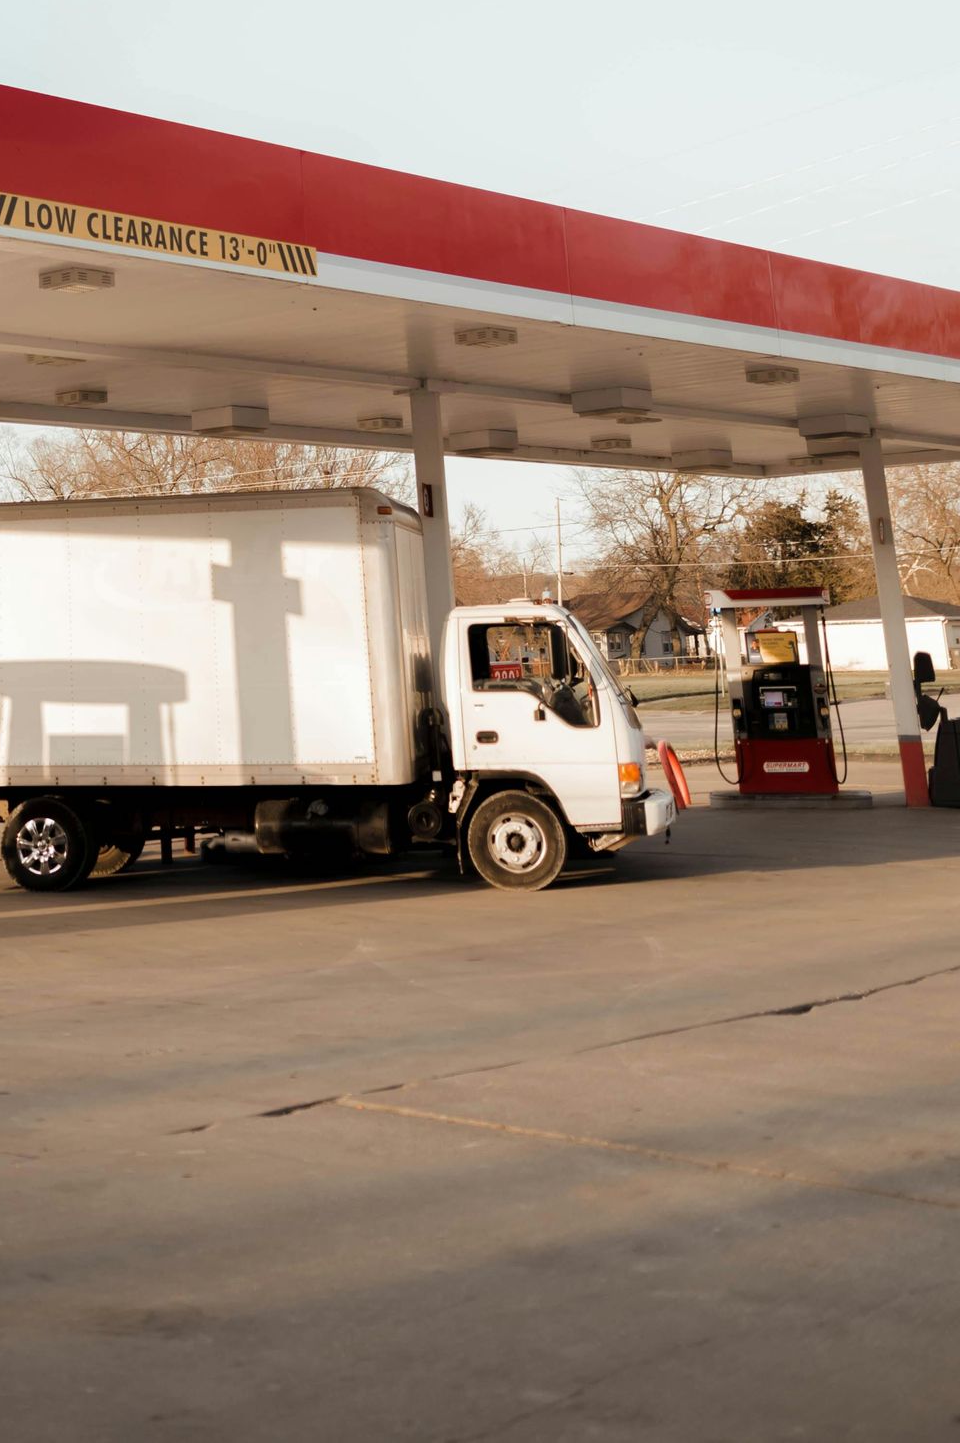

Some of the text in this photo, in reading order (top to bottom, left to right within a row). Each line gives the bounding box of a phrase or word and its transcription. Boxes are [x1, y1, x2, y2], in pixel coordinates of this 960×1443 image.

[24, 200, 276, 266] LOW CLEARANCE 13'-0"
